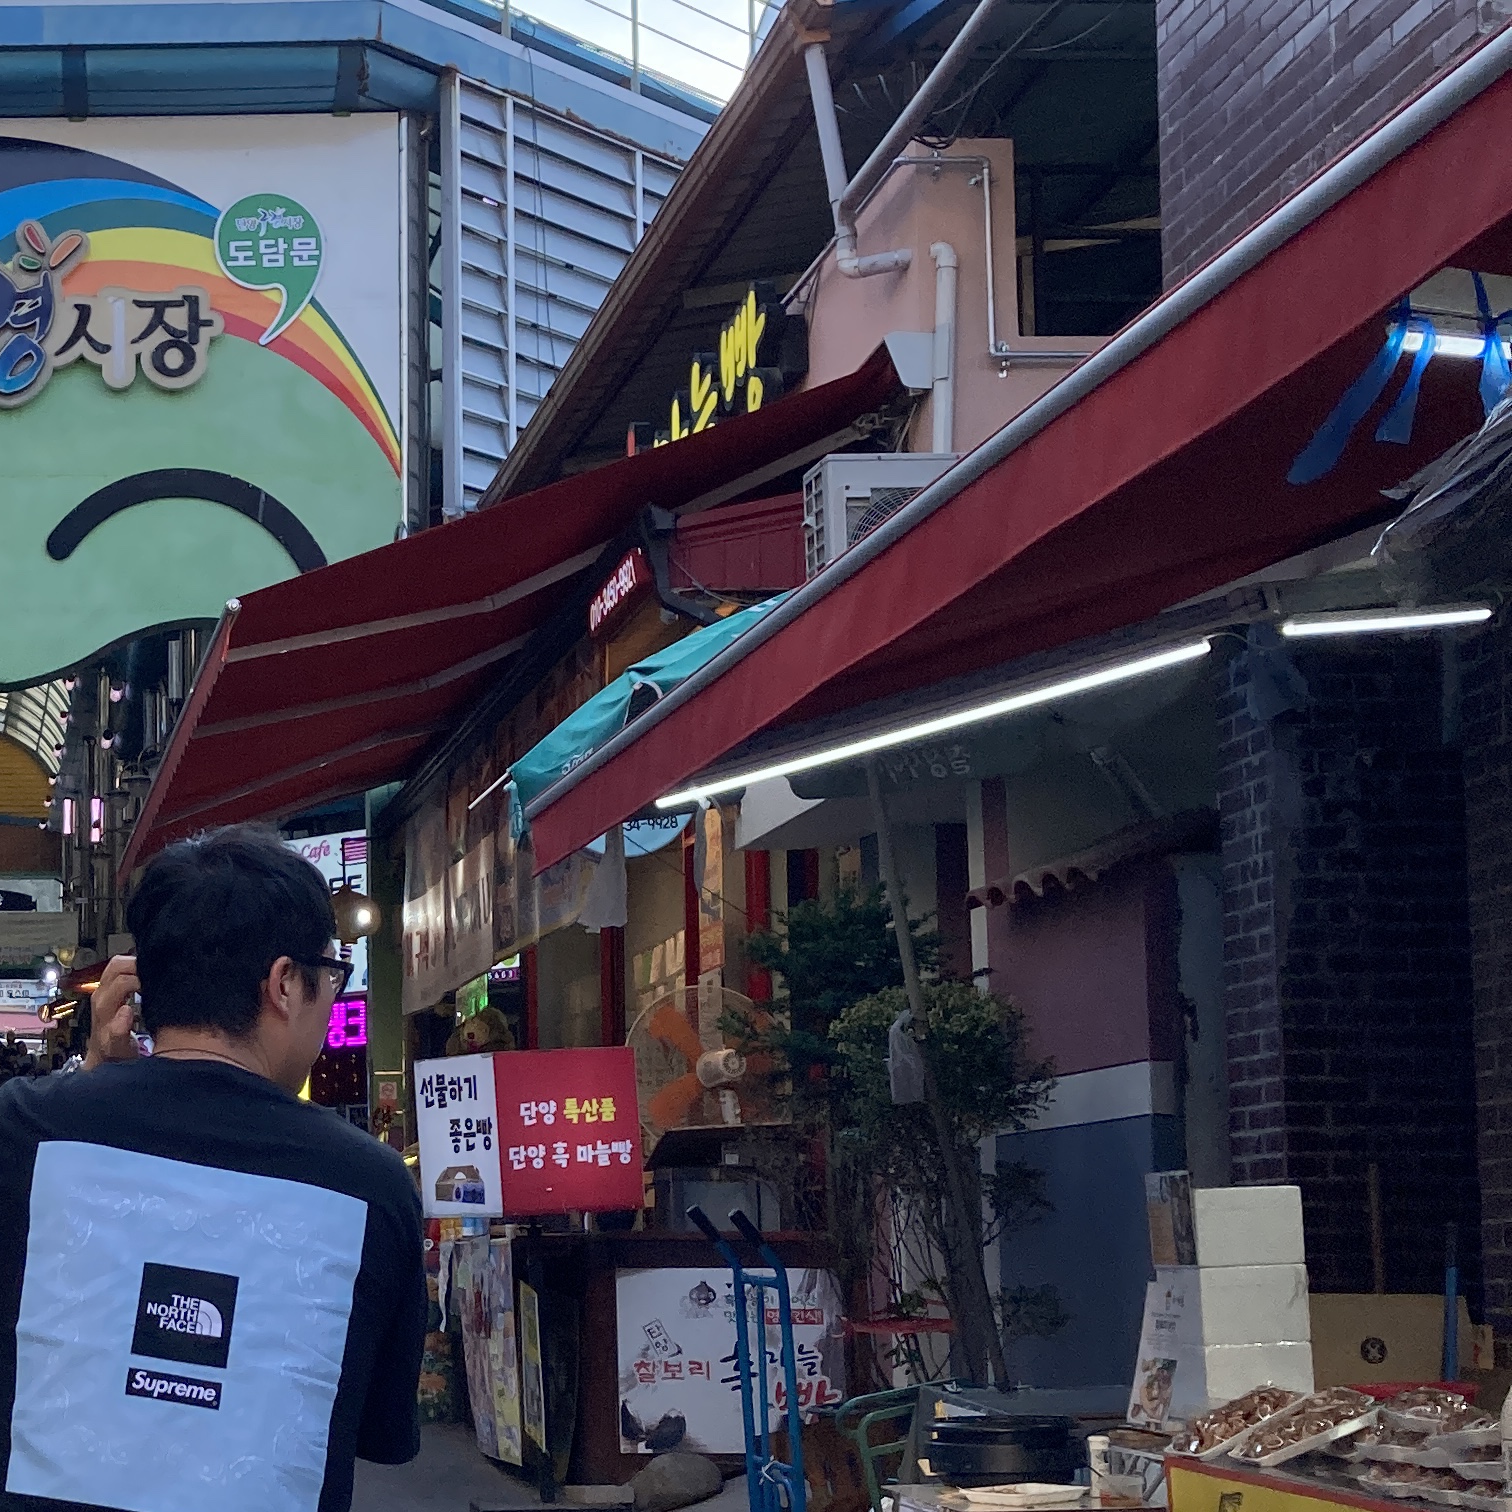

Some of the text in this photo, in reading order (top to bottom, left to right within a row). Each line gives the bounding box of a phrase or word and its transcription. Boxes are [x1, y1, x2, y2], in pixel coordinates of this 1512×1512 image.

[226, 237, 320, 268] 도담문
[301, 840, 331, 863] Cafe
[419, 1075, 477, 1109] 선물하기
[519, 1096, 617, 1126] 단양 특산품
[449, 1118, 492, 1152] 좋은빵
[508, 1139, 633, 1170] 단양 흑 마늘빵
[146, 1302, 198, 1322] NORTH
[171, 1294, 200, 1310] THE
[159, 1317, 197, 1334] FACE
[131, 1370, 217, 1402] Supreme
[633, 1360, 712, 1384] 찰보리
